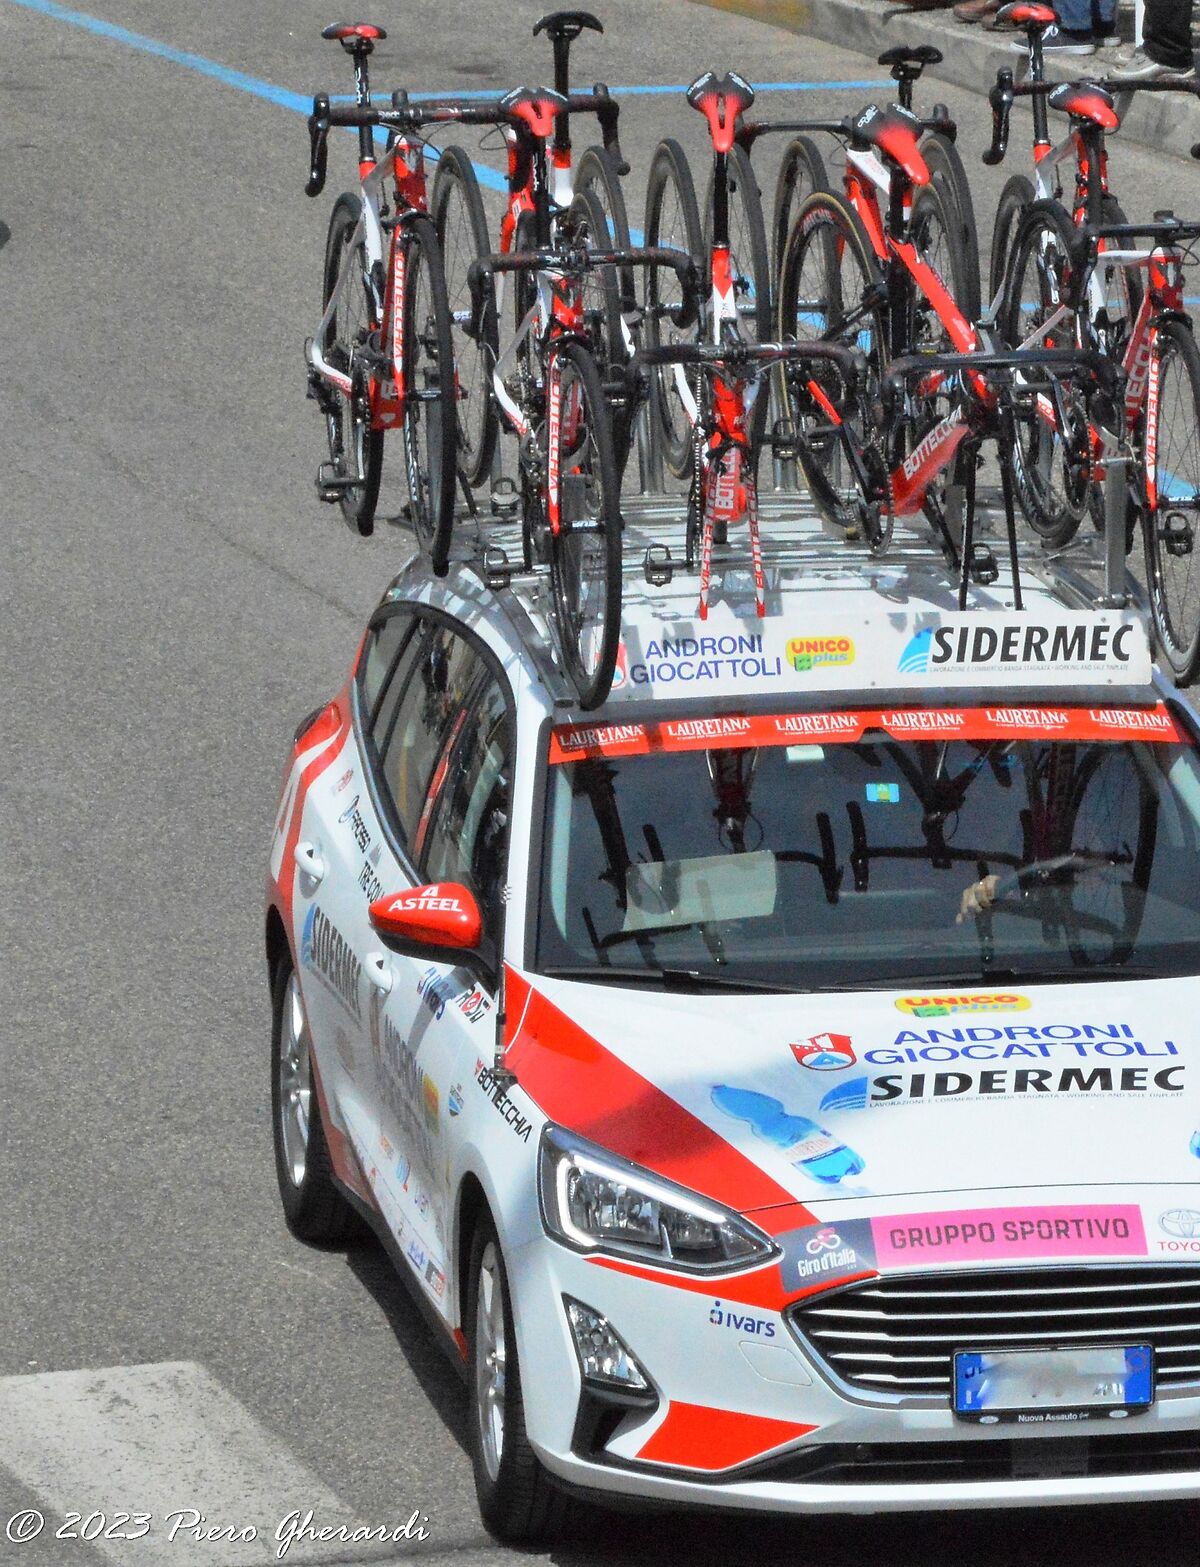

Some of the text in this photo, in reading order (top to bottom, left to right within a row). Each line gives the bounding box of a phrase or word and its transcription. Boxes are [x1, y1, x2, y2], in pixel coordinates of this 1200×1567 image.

[645, 634, 763, 660] ANDRONI
[791, 639, 850, 654] UNICO
[932, 624, 1134, 664] SIDERMEC
[630, 656, 781, 684] GIOCATTOLI
[812, 652, 848, 665] plus
[560, 725, 643, 746] LAURETANA
[667, 717, 751, 736] LAURETANA
[775, 715, 858, 731] LAURETANA
[882, 712, 964, 727] LAURETANA
[986, 709, 1069, 724] LAURETANA
[1090, 710, 1171, 727] LAURETANA
[388, 897, 463, 913] ASTEEL
[905, 994, 1019, 1007] UNICO
[951, 1002, 1017, 1013] plus
[894, 1023, 1135, 1046] ANDRONI
[864, 1040, 1179, 1065] GIOCATTOLI
[871, 1065, 1186, 1101] SIDERMEC
[890, 1217, 1130, 1250] GRUPPO SPORTIVO
[797, 1248, 857, 1277] Giro d'Italia
[1018, 1414, 1044, 1423] Nuova
